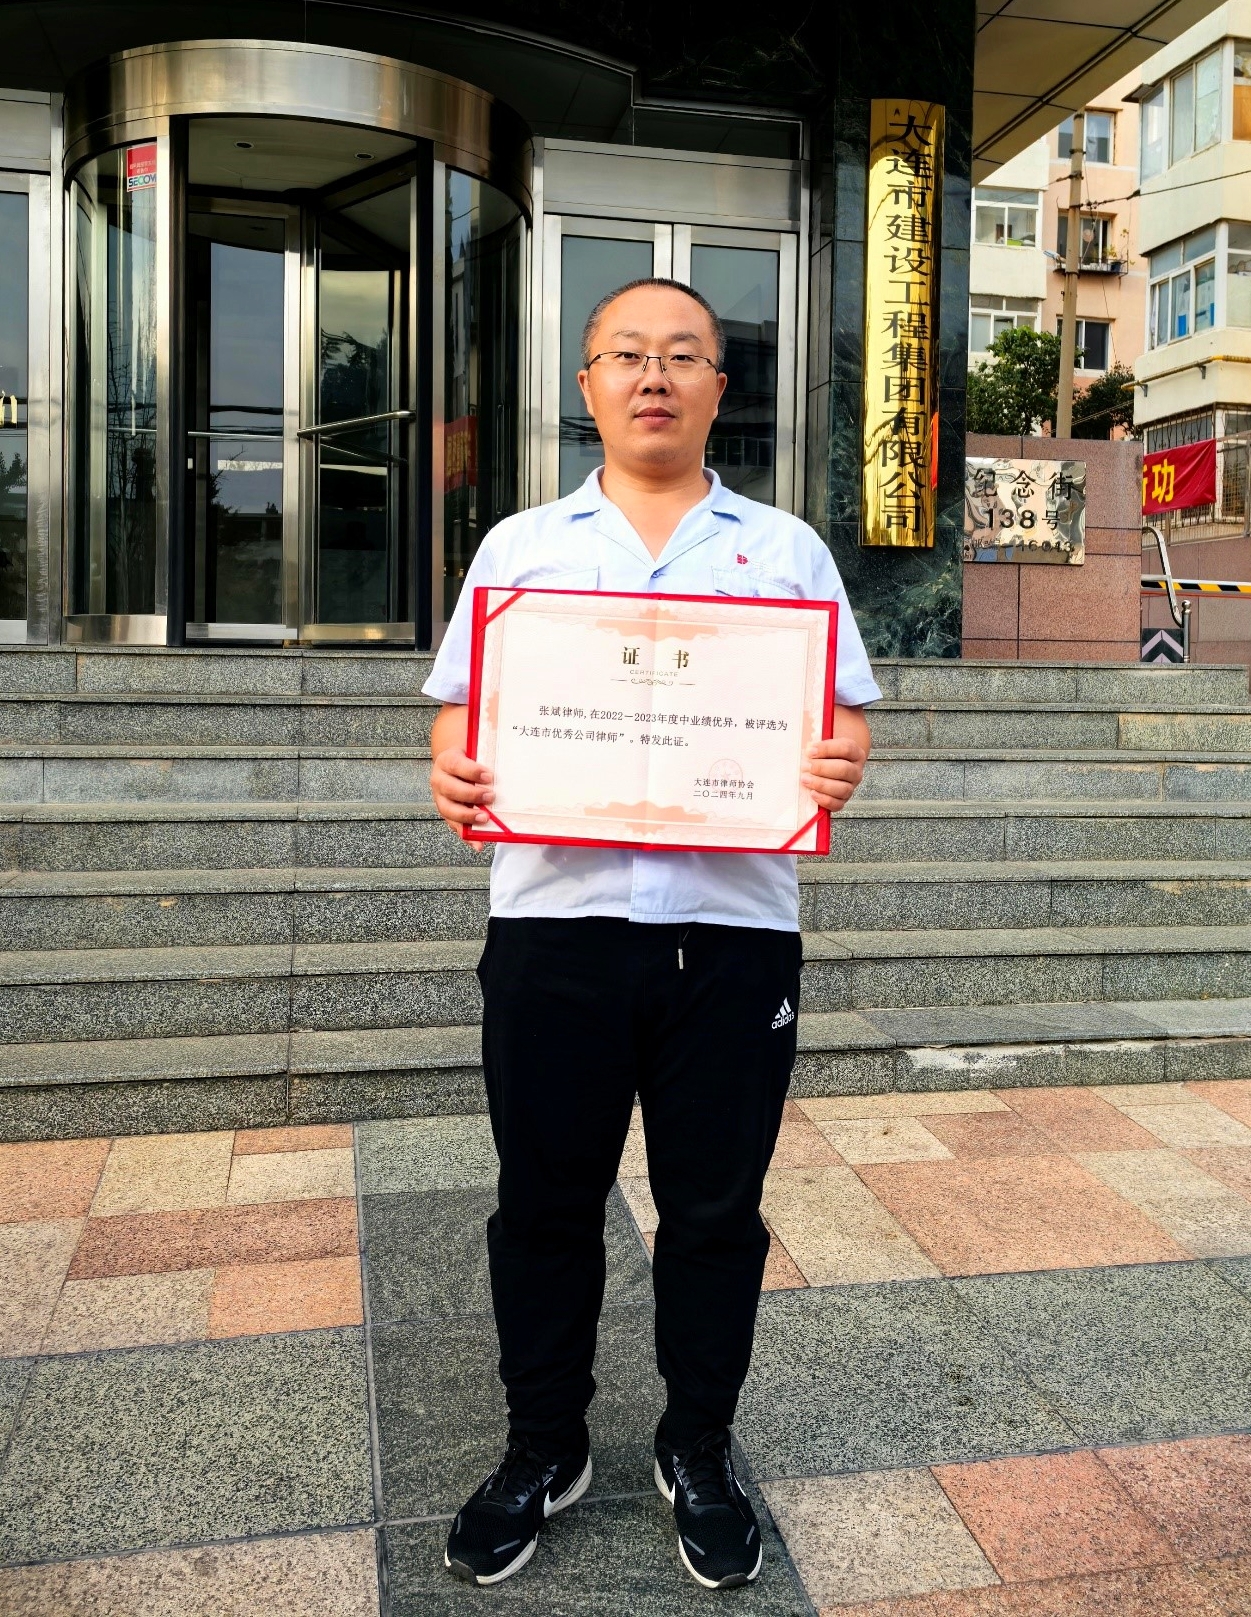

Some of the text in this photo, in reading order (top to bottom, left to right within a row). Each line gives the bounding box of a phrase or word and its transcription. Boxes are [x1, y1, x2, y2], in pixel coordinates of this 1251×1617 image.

[879, 114, 933, 532] 大连市建设工程集团有限公司
[972, 468, 1074, 500] 纪念街
[1143, 458, 1175, 506] 功
[983, 508, 1061, 530] 138号
[629, 669, 679, 677] CERTIFICATE
[694, 778, 754, 789] 大连市律师协会
[771, 1011, 795, 1029] adidas
